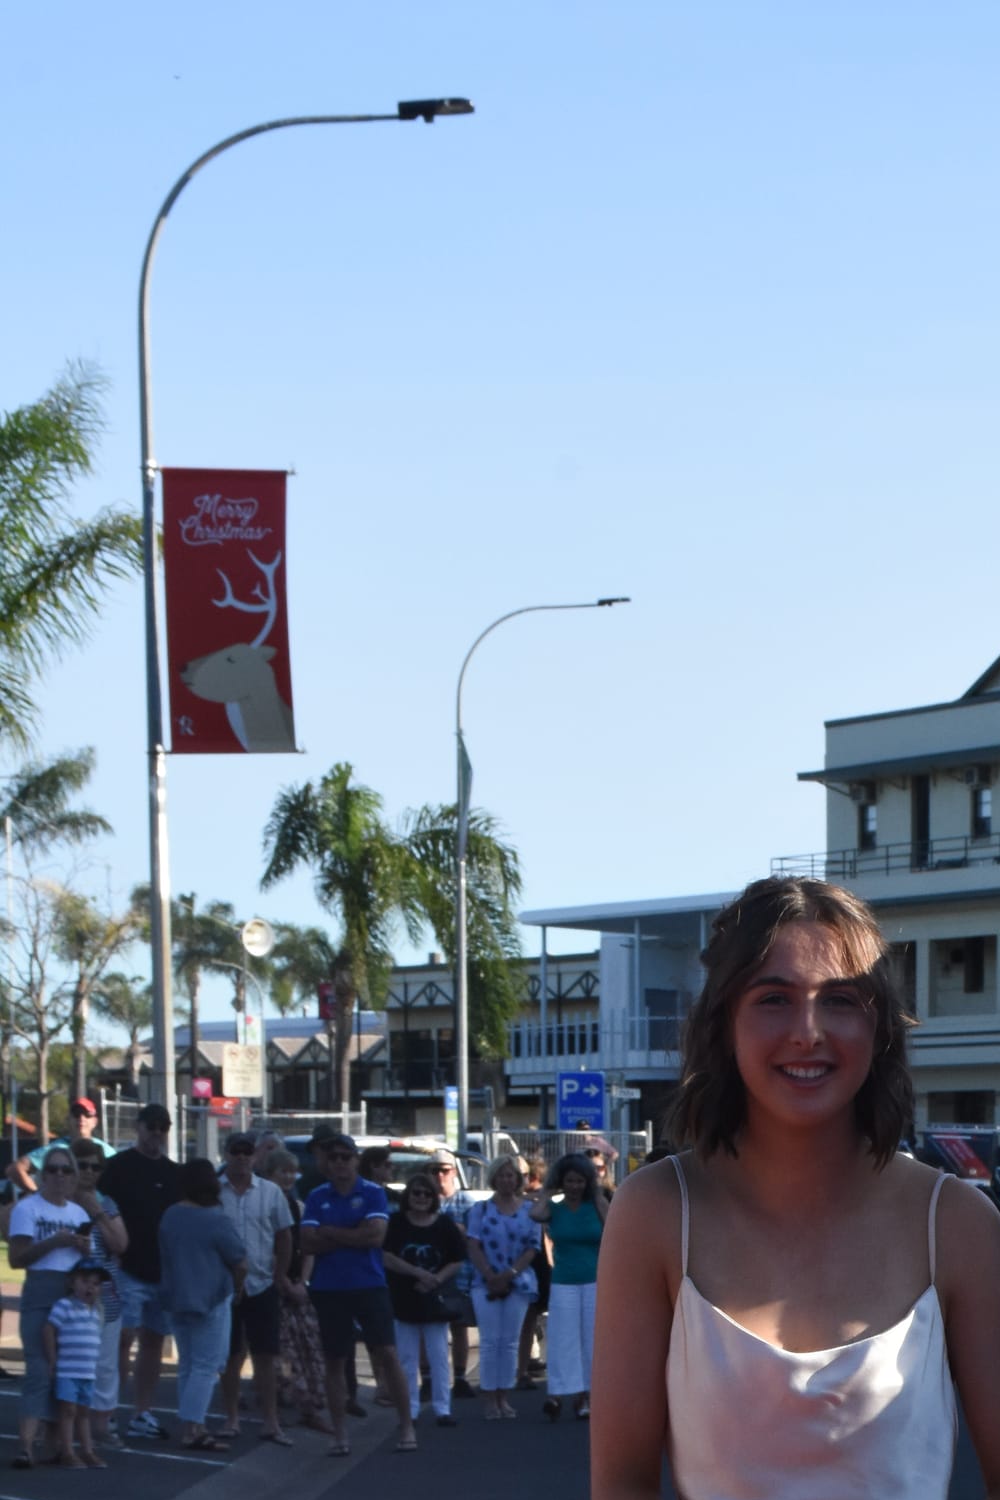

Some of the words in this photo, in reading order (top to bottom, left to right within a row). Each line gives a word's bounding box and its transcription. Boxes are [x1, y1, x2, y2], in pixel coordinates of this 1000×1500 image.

[193, 494, 259, 526] Merry
[177, 515, 273, 545] Christmas
[562, 1079, 579, 1100] P
